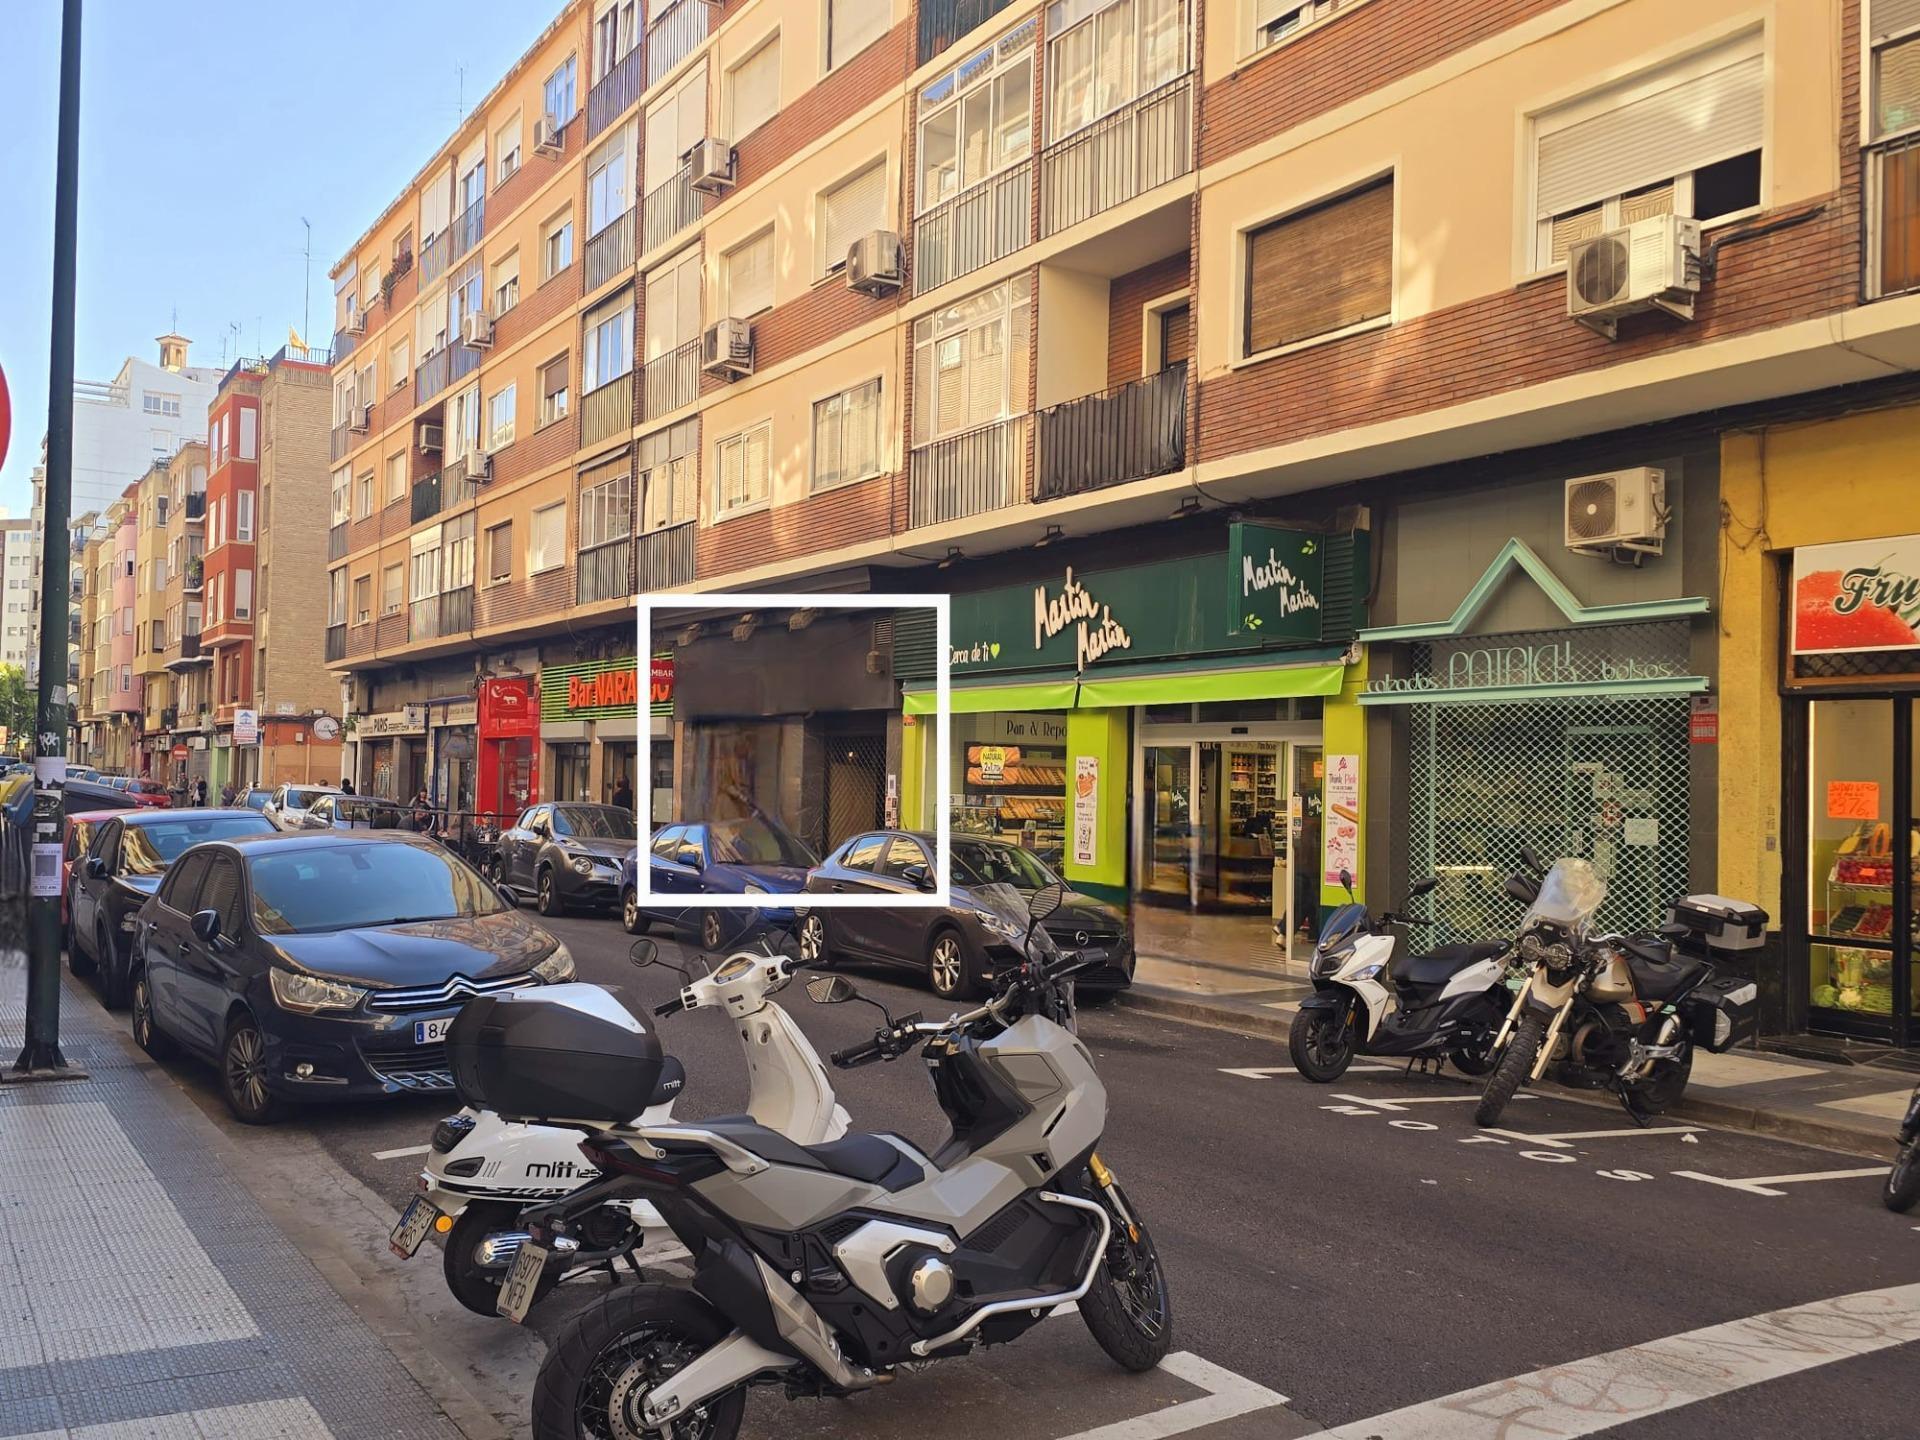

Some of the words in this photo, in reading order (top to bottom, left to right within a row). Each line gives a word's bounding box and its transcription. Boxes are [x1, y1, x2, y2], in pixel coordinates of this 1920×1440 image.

[971, 641, 981, 662] de
[1366, 672, 1438, 694] calzados
[1449, 641, 1578, 689] PATRICK
[1601, 658, 1673, 682] bolsos
[568, 675, 594, 708] Bar
[374, 717, 388, 733] PARIS
[1006, 720, 1024, 736] Pan
[1030, 721, 1038, 736] &
[663, 1079, 682, 1090] mitt
[1318, 1105, 1655, 1182] MOTOS
[525, 1160, 577, 1179] mitt
[514, 1251, 543, 1284] 6977
